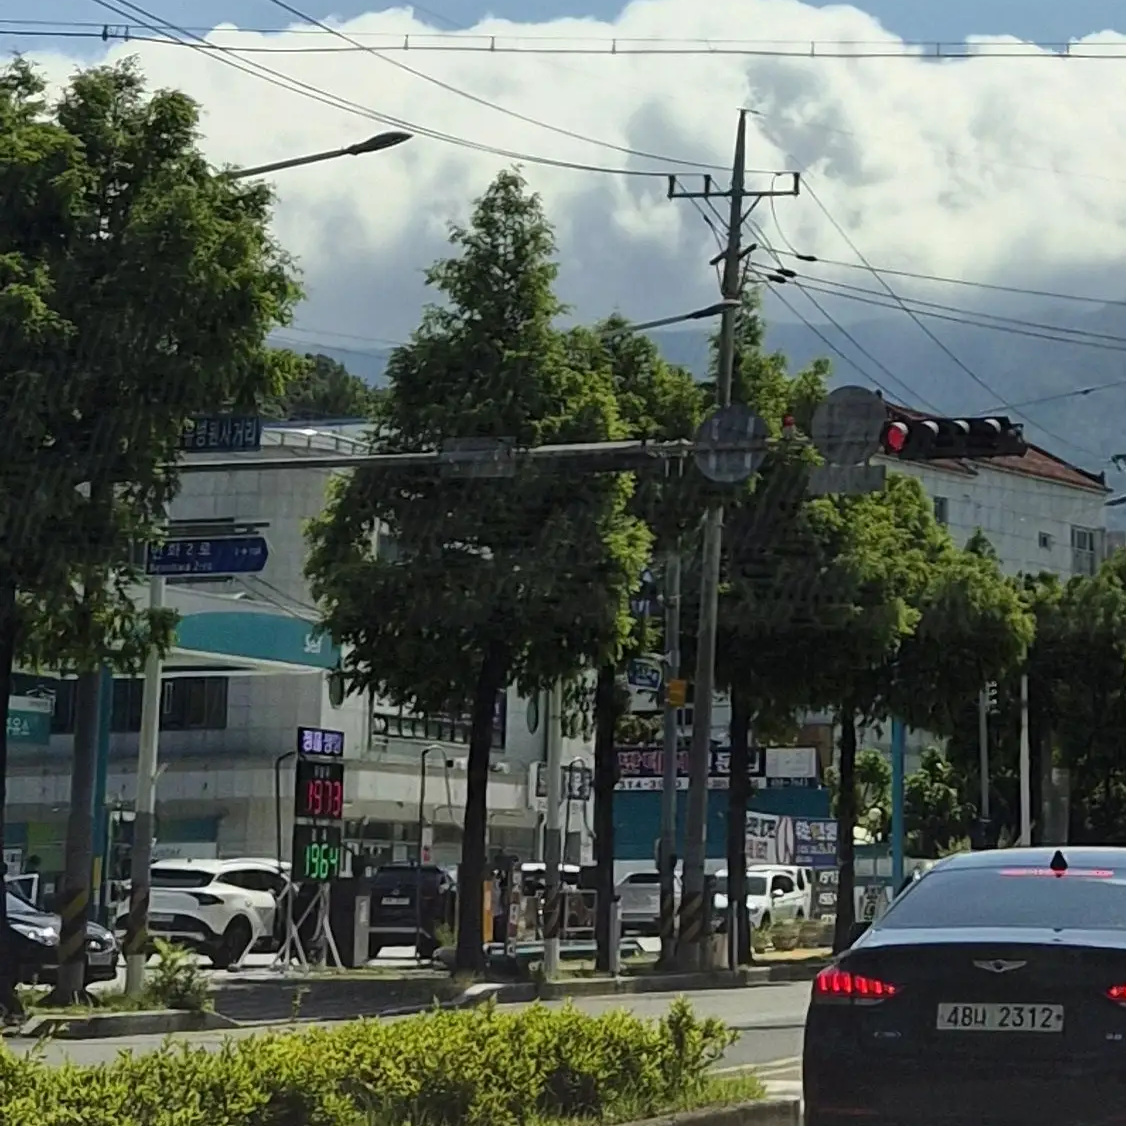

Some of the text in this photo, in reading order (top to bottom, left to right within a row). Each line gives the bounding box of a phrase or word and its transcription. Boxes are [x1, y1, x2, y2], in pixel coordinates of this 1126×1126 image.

[306, 779, 342, 817] 1973
[304, 843, 339, 879] 1964
[999, 1007, 1053, 1028] 2312
